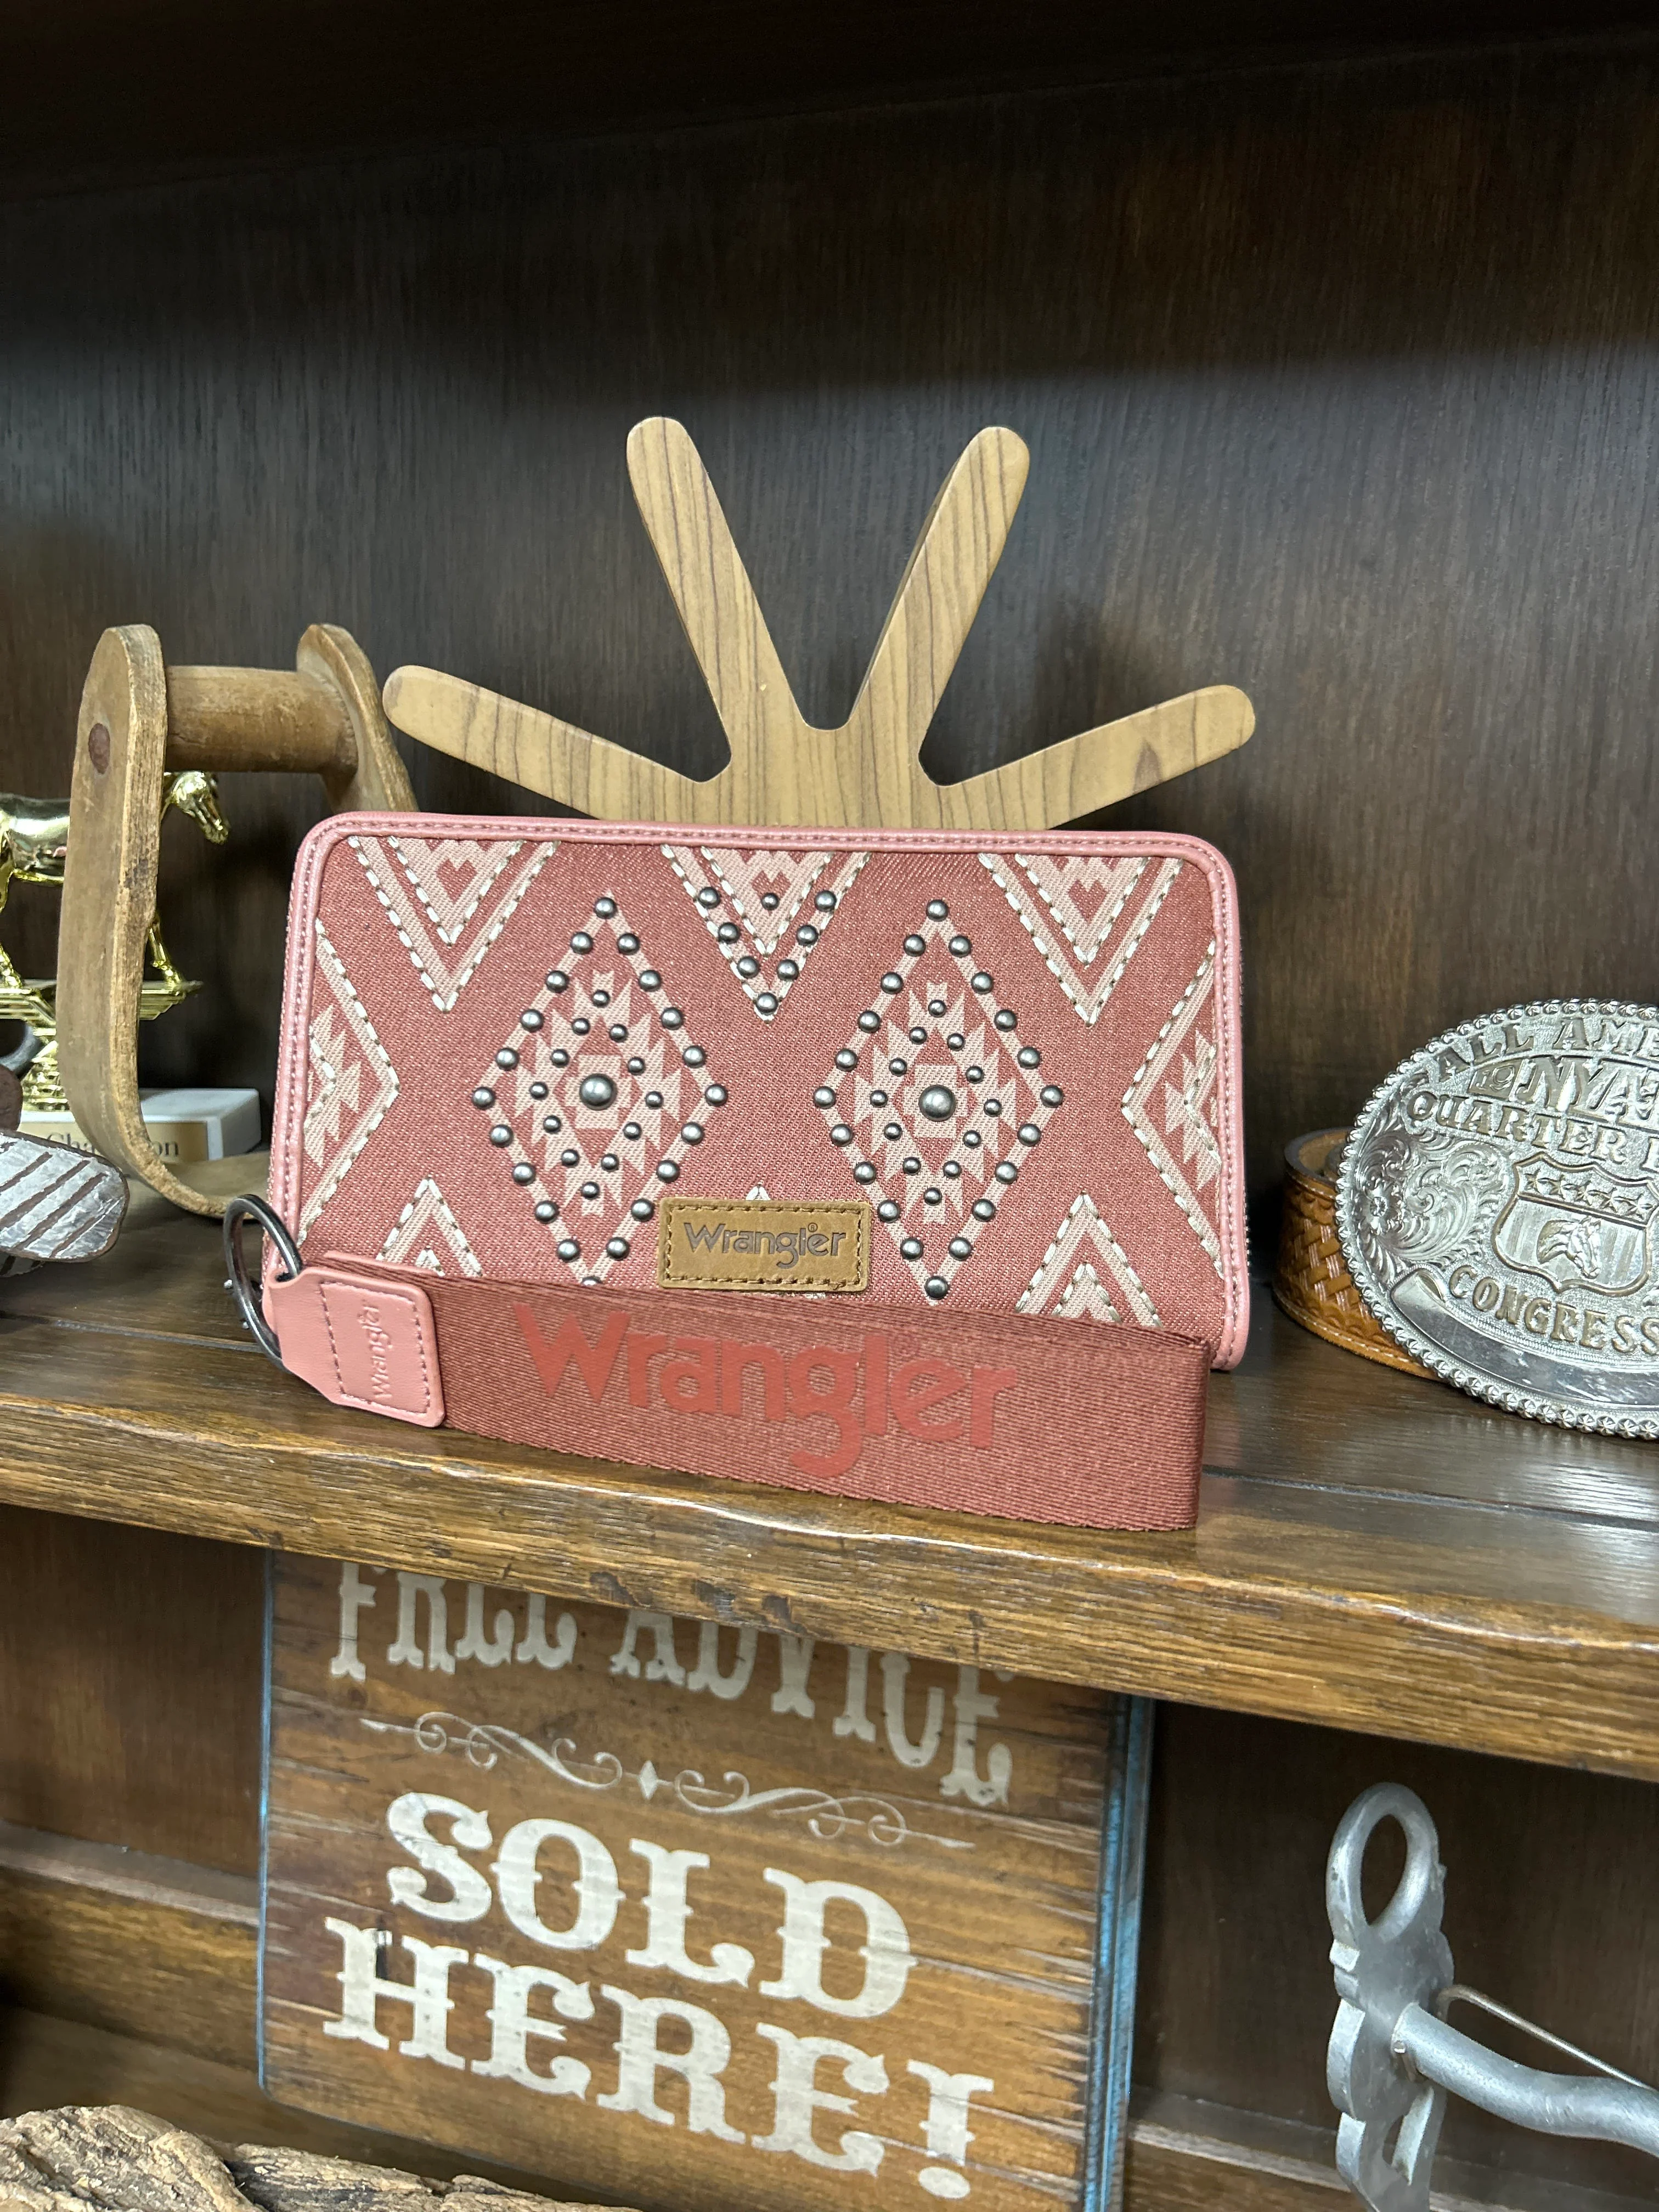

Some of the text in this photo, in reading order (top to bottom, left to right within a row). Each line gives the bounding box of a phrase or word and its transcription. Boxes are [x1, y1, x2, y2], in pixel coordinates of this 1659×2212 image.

[1435, 1023, 1533, 1082] ALL
[1516, 1054, 1659, 1127] NYA
[1406, 1091, 1627, 1165] QUARTER
[684, 1222, 847, 1269] Wrangler
[1448, 1265, 1659, 1356] CONGRESS
[514, 1304, 1018, 1479] Wrangler
[385, 1792, 918, 2019] SOLD
[323, 1917, 994, 2199] HERE!
